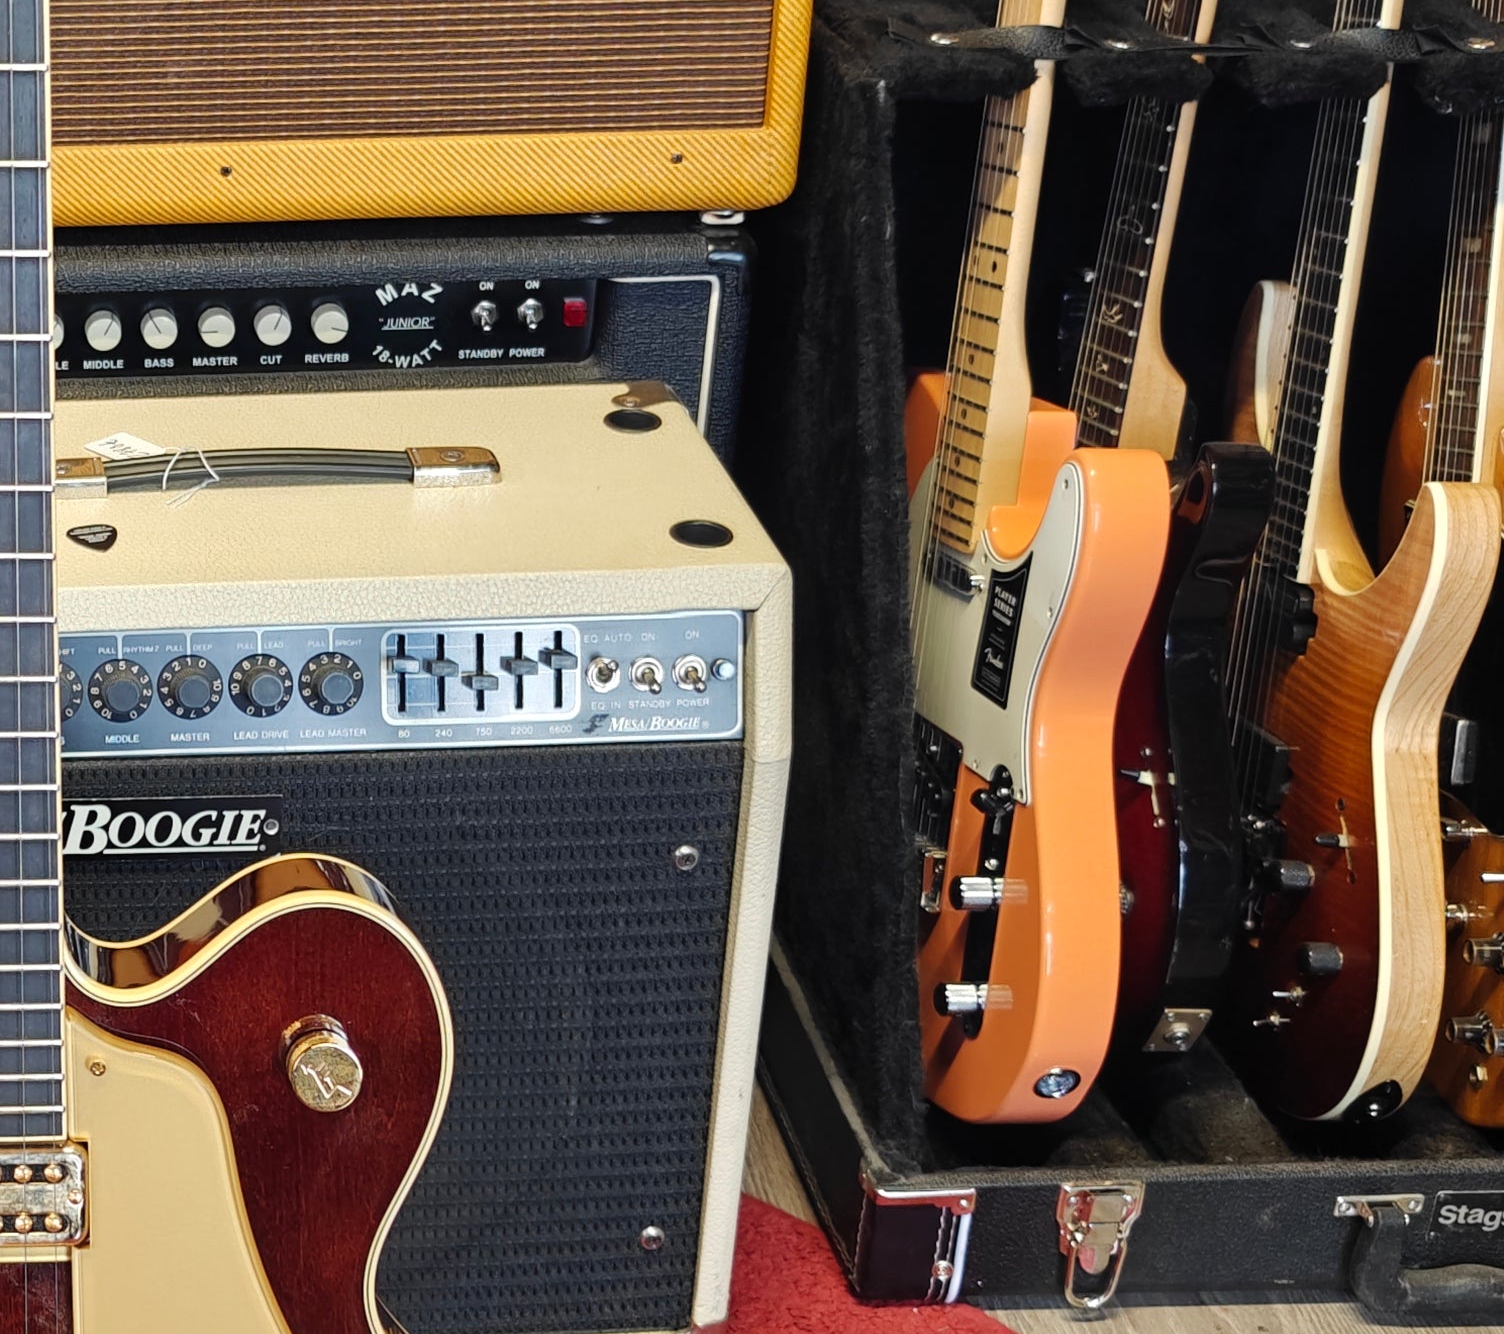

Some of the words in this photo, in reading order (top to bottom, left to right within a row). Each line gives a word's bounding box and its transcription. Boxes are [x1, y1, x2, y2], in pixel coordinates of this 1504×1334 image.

[375, 282, 444, 307] MAZ
[479, 281, 495, 291] ON
[524, 280, 540, 290] ON
[372, 339, 443, 369] 18-WATT
[458, 347, 504, 359] STANDBY
[508, 346, 545, 358] POWER
[83, 359, 125, 370] MIDDLE
[144, 358, 175, 368] BASS
[192, 356, 238, 367] MASTER
[259, 354, 283, 365] CUT
[304, 353, 349, 364] REVERB
[994, 585, 1017, 608] PLAYER
[993, 597, 1014, 618] SERIES
[584, 634, 599, 644] EQ
[604, 632, 633, 643] AUTO
[640, 632, 656, 642] ON
[684, 630, 700, 640] ON
[98, 646, 117, 655] PULL
[165, 644, 184, 653] PULL
[308, 640, 326, 649] PULL
[591, 701, 606, 711] EQ
[627, 698, 672, 710] STANDBY
[676, 697, 710, 708] POWER
[607, 714, 701, 733] MESA/BOOGIE
[170, 732, 211, 743] MASTER
[233, 730, 258, 741] LEAD
[261, 729, 290, 740] DRIVE
[299, 729, 326, 739] LEAD
[328, 727, 367, 738] MASTER
[398, 729, 410, 738] 80
[435, 728, 453, 738] 240
[475, 727, 492, 737] 750
[510, 725, 534, 736] 2200
[105, 733, 141, 744] MIDDLE
[1438, 1204, 1504, 1232] Stag
